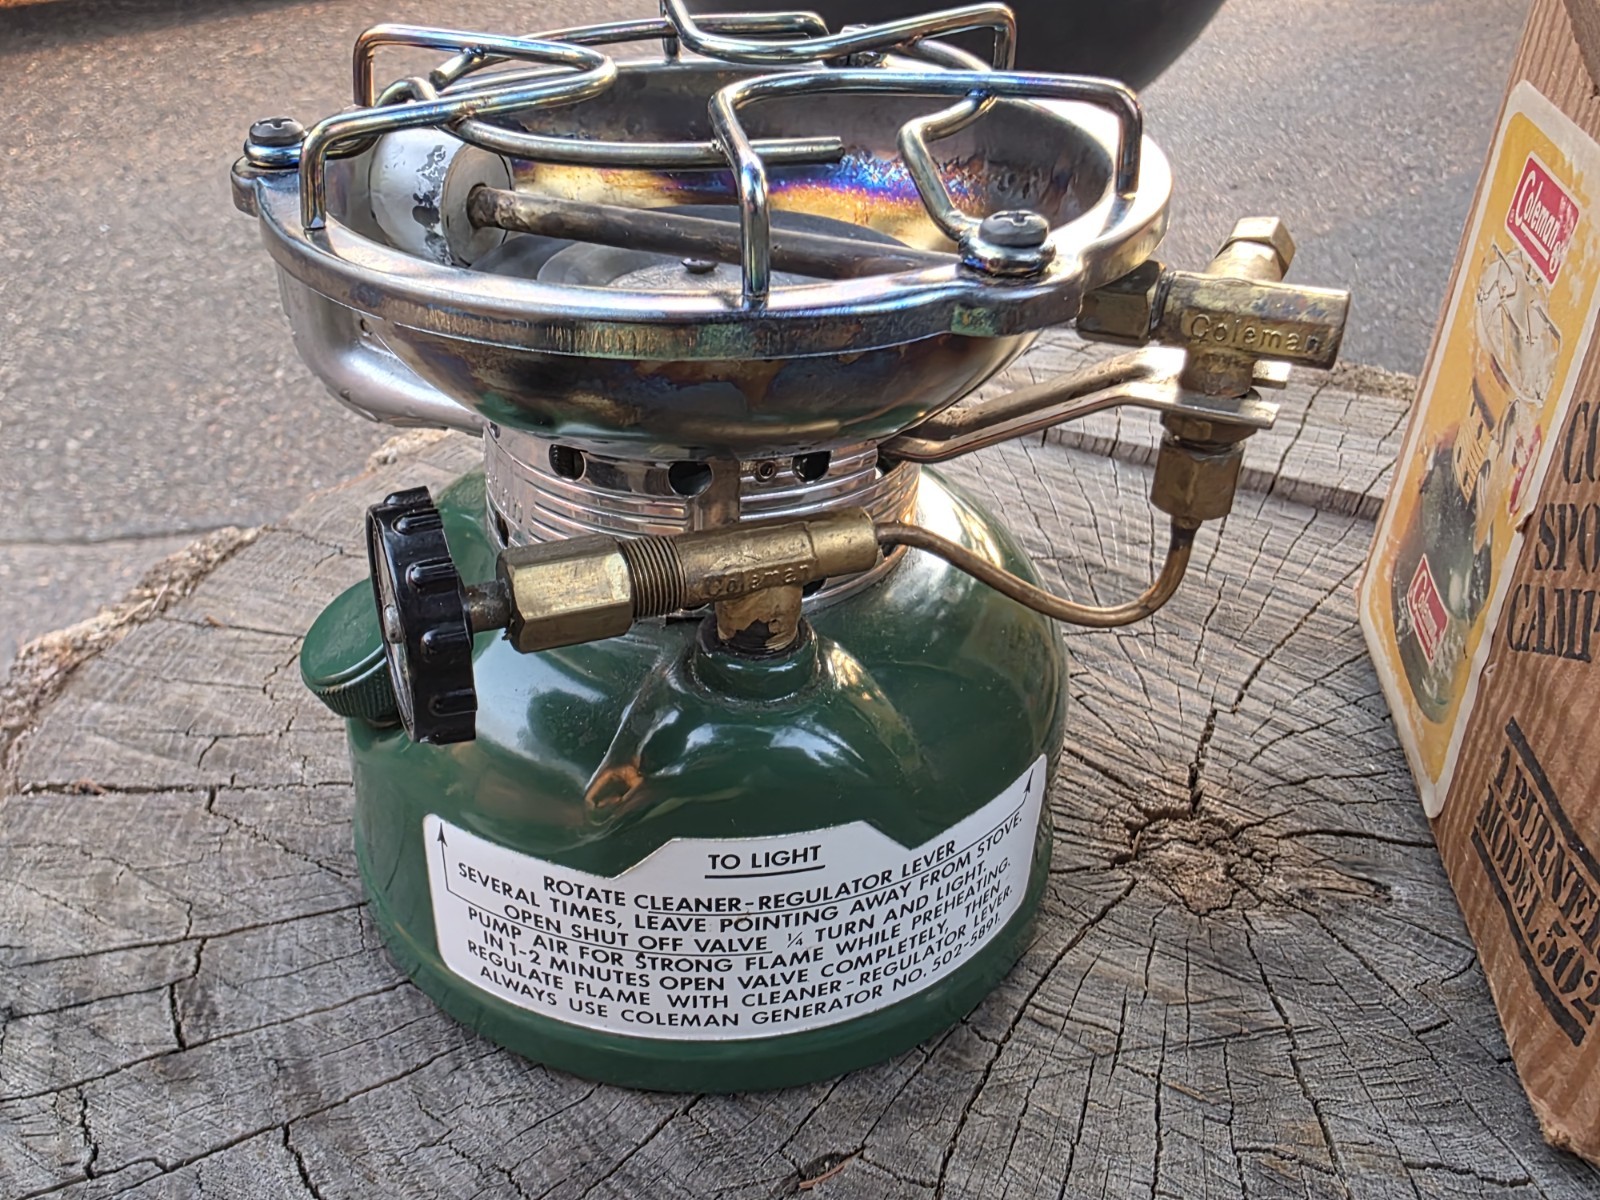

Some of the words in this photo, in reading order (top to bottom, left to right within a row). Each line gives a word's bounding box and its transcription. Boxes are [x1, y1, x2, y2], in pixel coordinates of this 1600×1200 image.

[1514, 169, 1561, 251] Coleman
[458, 862, 540, 907] SEVERAL
[550, 898, 622, 928] TIMES,
[635, 914, 706, 932] LEAVE
[720, 906, 838, 933] POINTING
[849, 883, 910, 915] AWAY
[919, 854, 971, 891] FROM
[977, 812, 1022, 858] STOVE.
[544, 875, 625, 906] ROTATE
[634, 870, 892, 911] CLEANER-REGULATOR
[901, 840, 956, 877] LEVER
[709, 854, 740, 870] TO
[751, 845, 821, 868] LIGHT
[468, 906, 522, 939] PUMP
[533, 935, 568, 955] AIR
[580, 946, 623, 967] FOR
[635, 955, 733, 973] STRONG
[745, 948, 823, 971] FLAME
[836, 924, 901, 955] WHILE
[912, 857, 1010, 930] PREHEATING.
[468, 940, 563, 989] REGULATE
[574, 982, 650, 1006] FLAME
[667, 994, 728, 1008] WITH
[973, 887, 1012, 929] LEVER.
[484, 931, 503, 950] IN
[510, 942, 541, 964] 1-2
[550, 957, 650, 987] MINUTES
[660, 976, 724, 991] OPEN
[738, 969, 808, 989] VALVE
[821, 920, 949, 977] COMPLETELY,
[964, 880, 1000, 918] THEN
[504, 905, 561, 933] OPEN
[572, 924, 628, 947] SHUT
[638, 936, 683, 951] OFF
[695, 936, 767, 953] VALVE
[815, 916, 874, 942] TURN
[883, 895, 929, 924] AND
[936, 860, 987, 904] LIGHT.
[480, 966, 557, 1006] ALWAYS
[569, 998, 608, 1017] USE
[621, 1009, 739, 1026] COLEMAN
[752, 984, 883, 1024] GENERATOR
[892, 968, 927, 991] NO.
